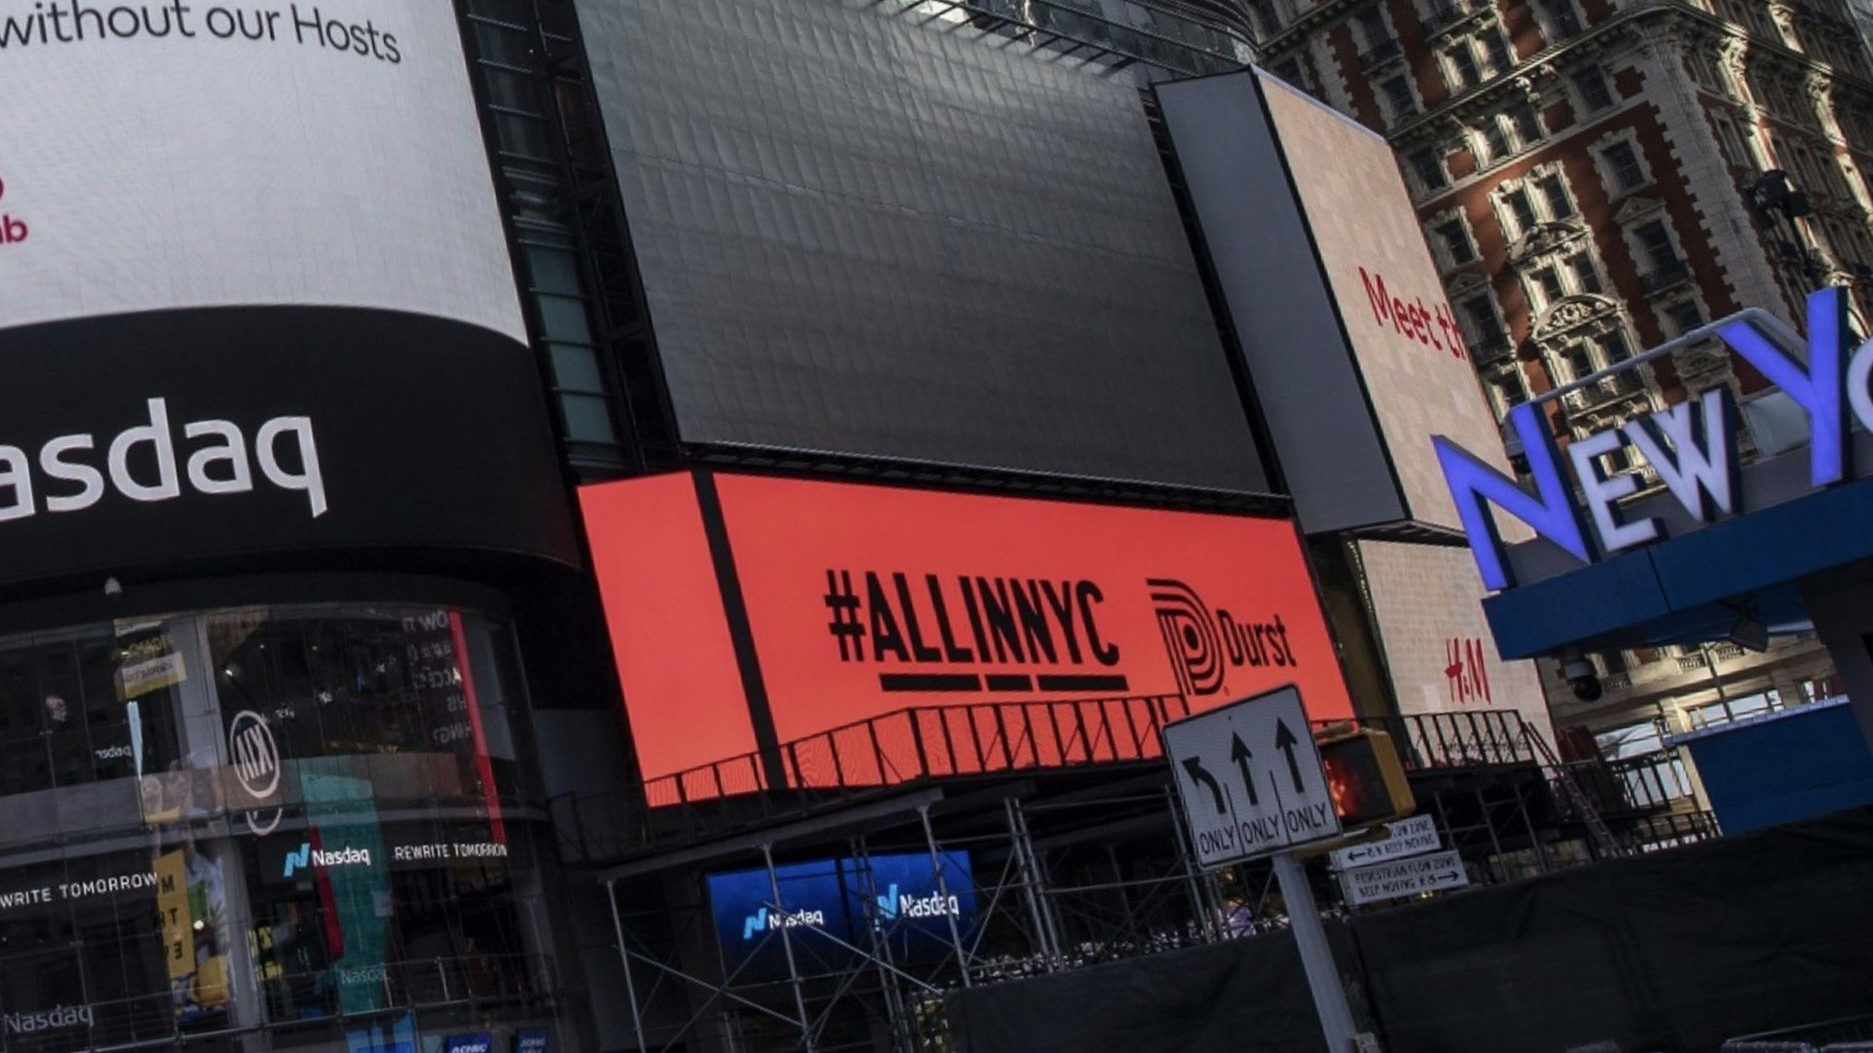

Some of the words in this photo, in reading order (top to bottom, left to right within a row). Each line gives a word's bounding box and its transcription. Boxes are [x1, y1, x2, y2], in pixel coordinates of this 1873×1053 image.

[207, 6, 280, 42] our
[290, 3, 402, 64] Hosts
[1358, 265, 1443, 351] Meet
[1430, 388, 1740, 592] NEW
[825, 569, 1119, 667] #ALLINNYC
[1216, 608, 1298, 668] Durst
[1242, 815, 1279, 844] ONLY
[1287, 802, 1327, 833] ONLY
[394, 843, 450, 861] REWRITE
[1199, 825, 1236, 854] ONLY
[312, 847, 371, 868] Nasdaq
[58, 872, 158, 899] TOMORROW
[4, 1004, 94, 1035] Nasdaq
